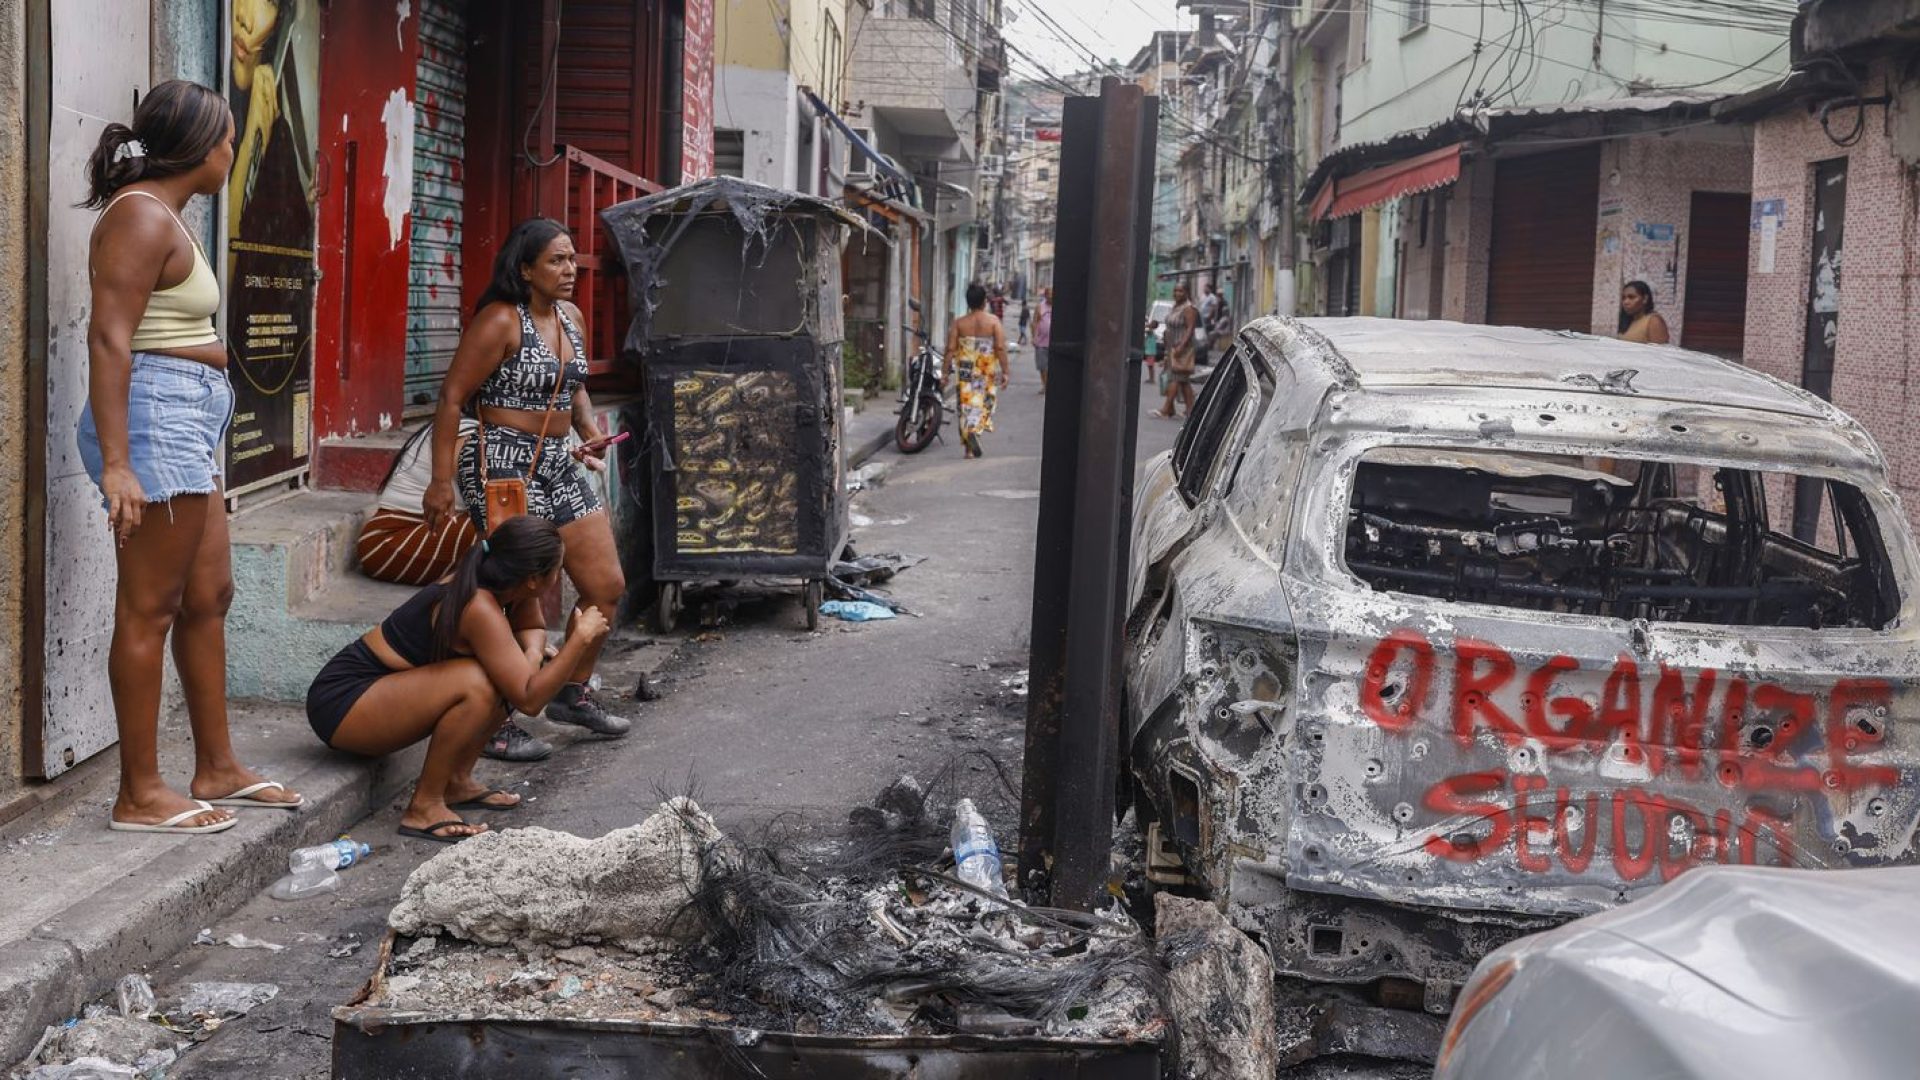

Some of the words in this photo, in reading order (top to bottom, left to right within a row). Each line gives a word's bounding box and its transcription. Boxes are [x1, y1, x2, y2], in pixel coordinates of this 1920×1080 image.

[517, 363, 546, 374] LIVES
[494, 443, 533, 464] LIVES
[486, 460, 514, 470] LIVES
[1360, 632, 1901, 791] ORGANIZE
